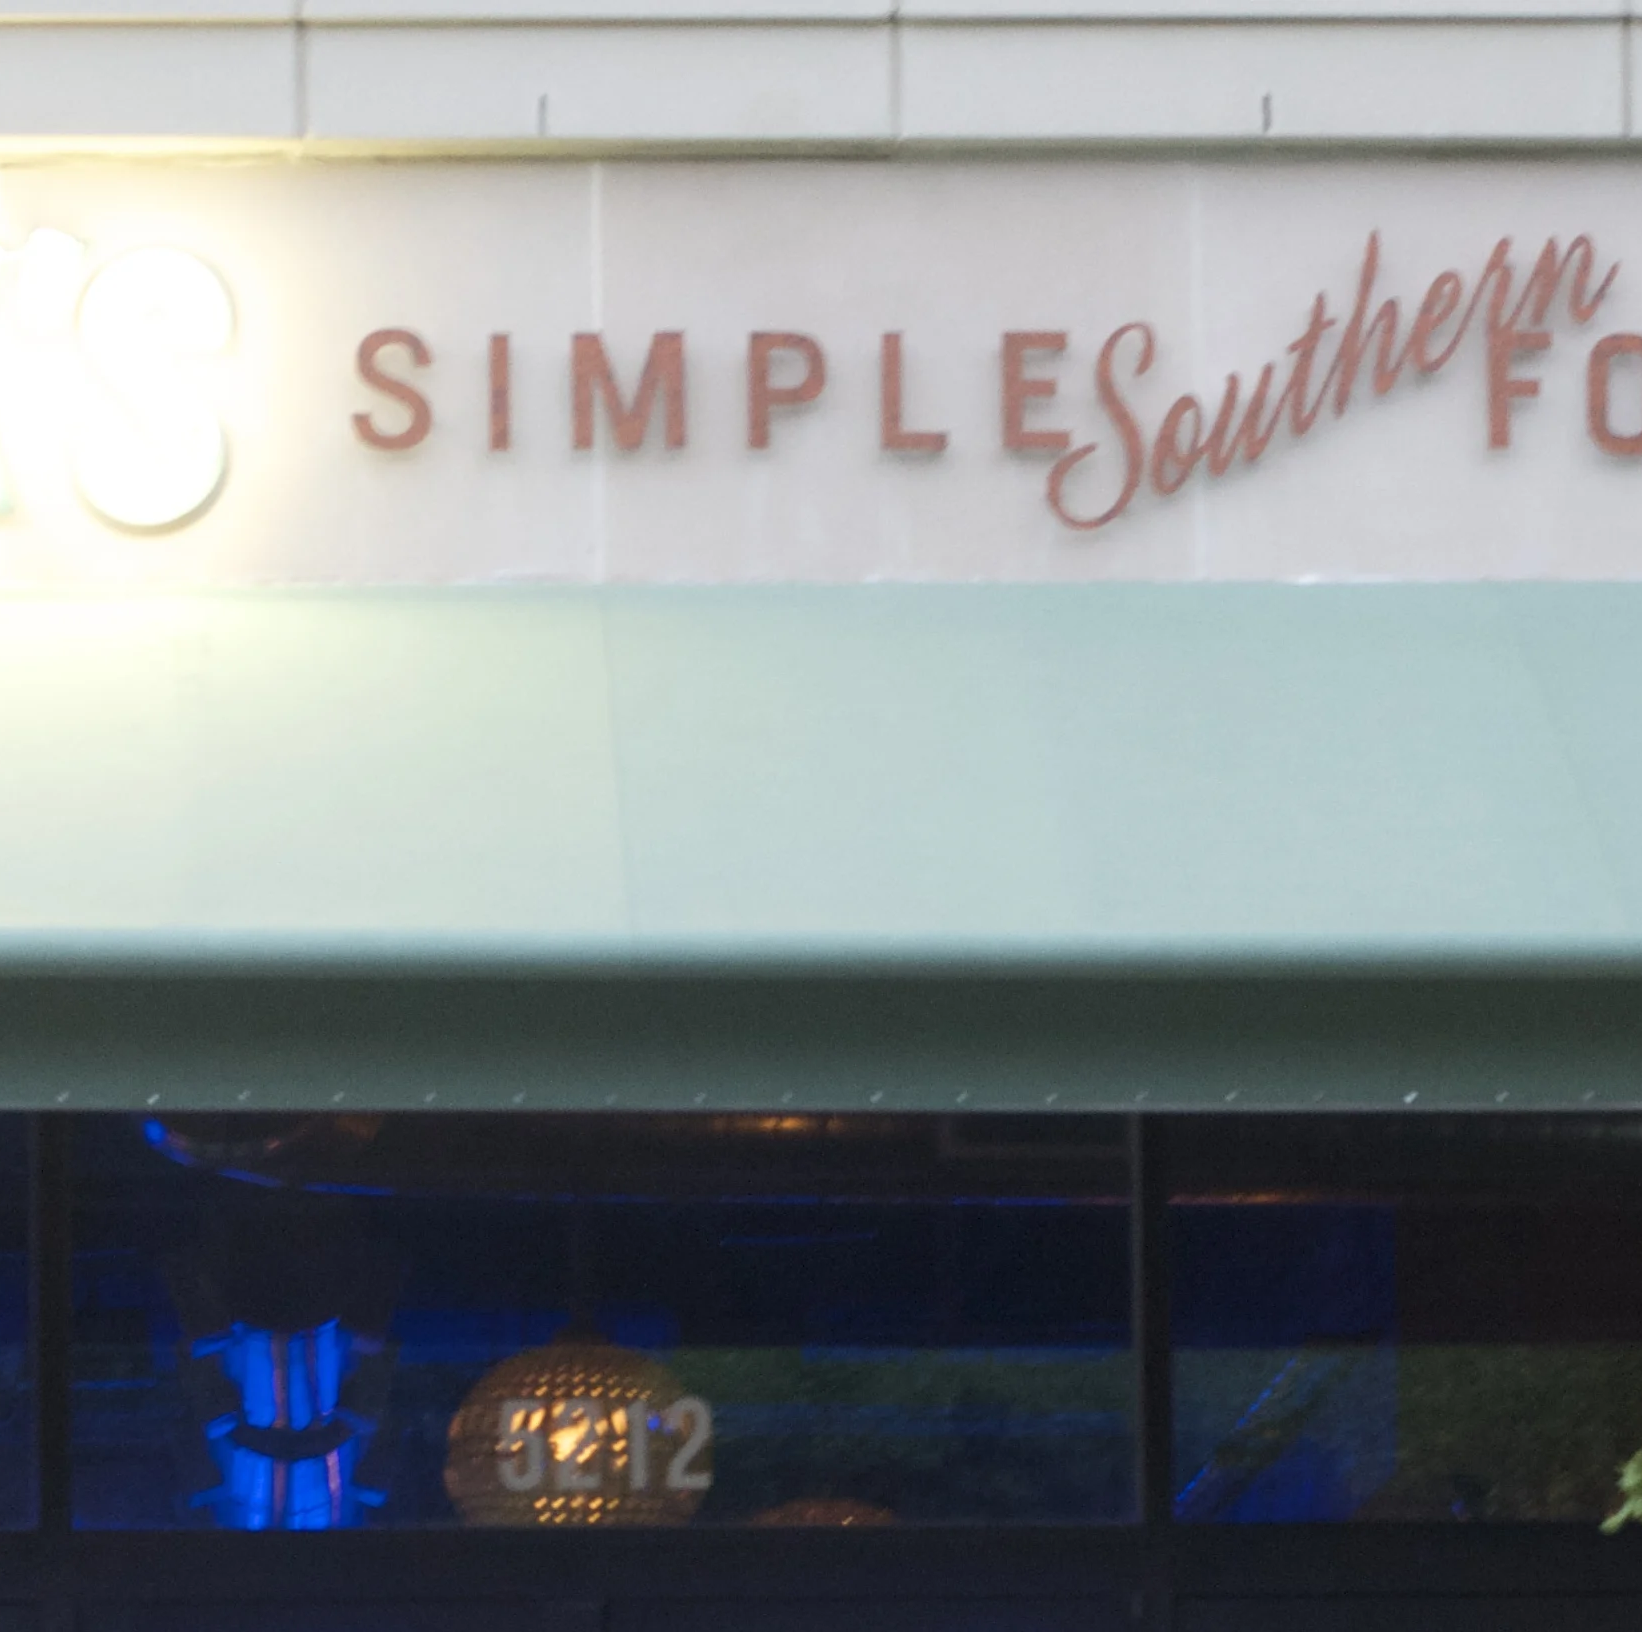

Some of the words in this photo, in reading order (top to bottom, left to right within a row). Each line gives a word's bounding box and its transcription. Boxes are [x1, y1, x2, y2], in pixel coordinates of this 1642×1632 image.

[353, 326, 1073, 455] SIMPLE
[1045, 230, 1623, 532] Southern
[496, 1396, 713, 1492] 5212
